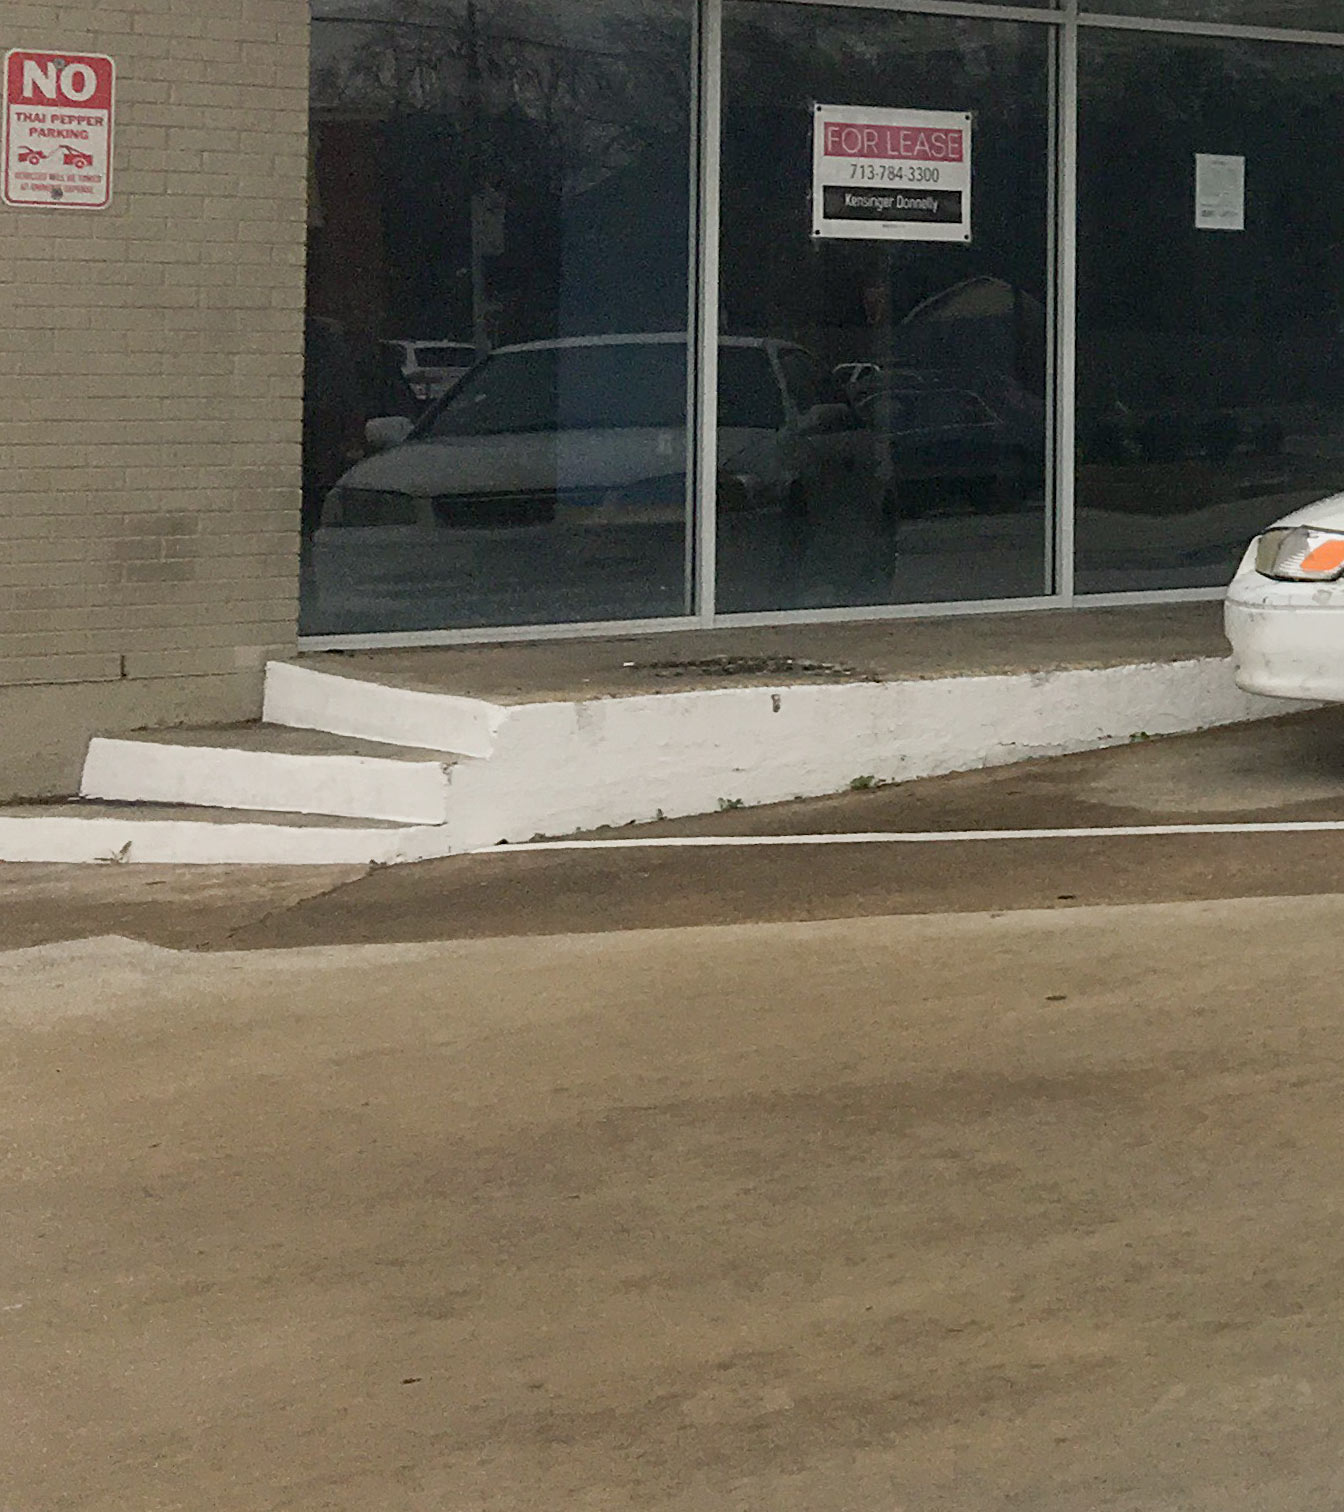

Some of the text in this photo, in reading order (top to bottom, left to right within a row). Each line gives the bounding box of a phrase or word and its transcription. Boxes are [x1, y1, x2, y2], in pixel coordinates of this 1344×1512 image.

[22, 59, 97, 101] NO
[15, 112, 104, 126] THAI PEPPER
[29, 127, 89, 140] PARKING
[827, 127, 960, 158] FOR LEASE
[850, 163, 940, 183] 713-784-3300
[844, 193, 939, 213] Kensinger Donnelly
